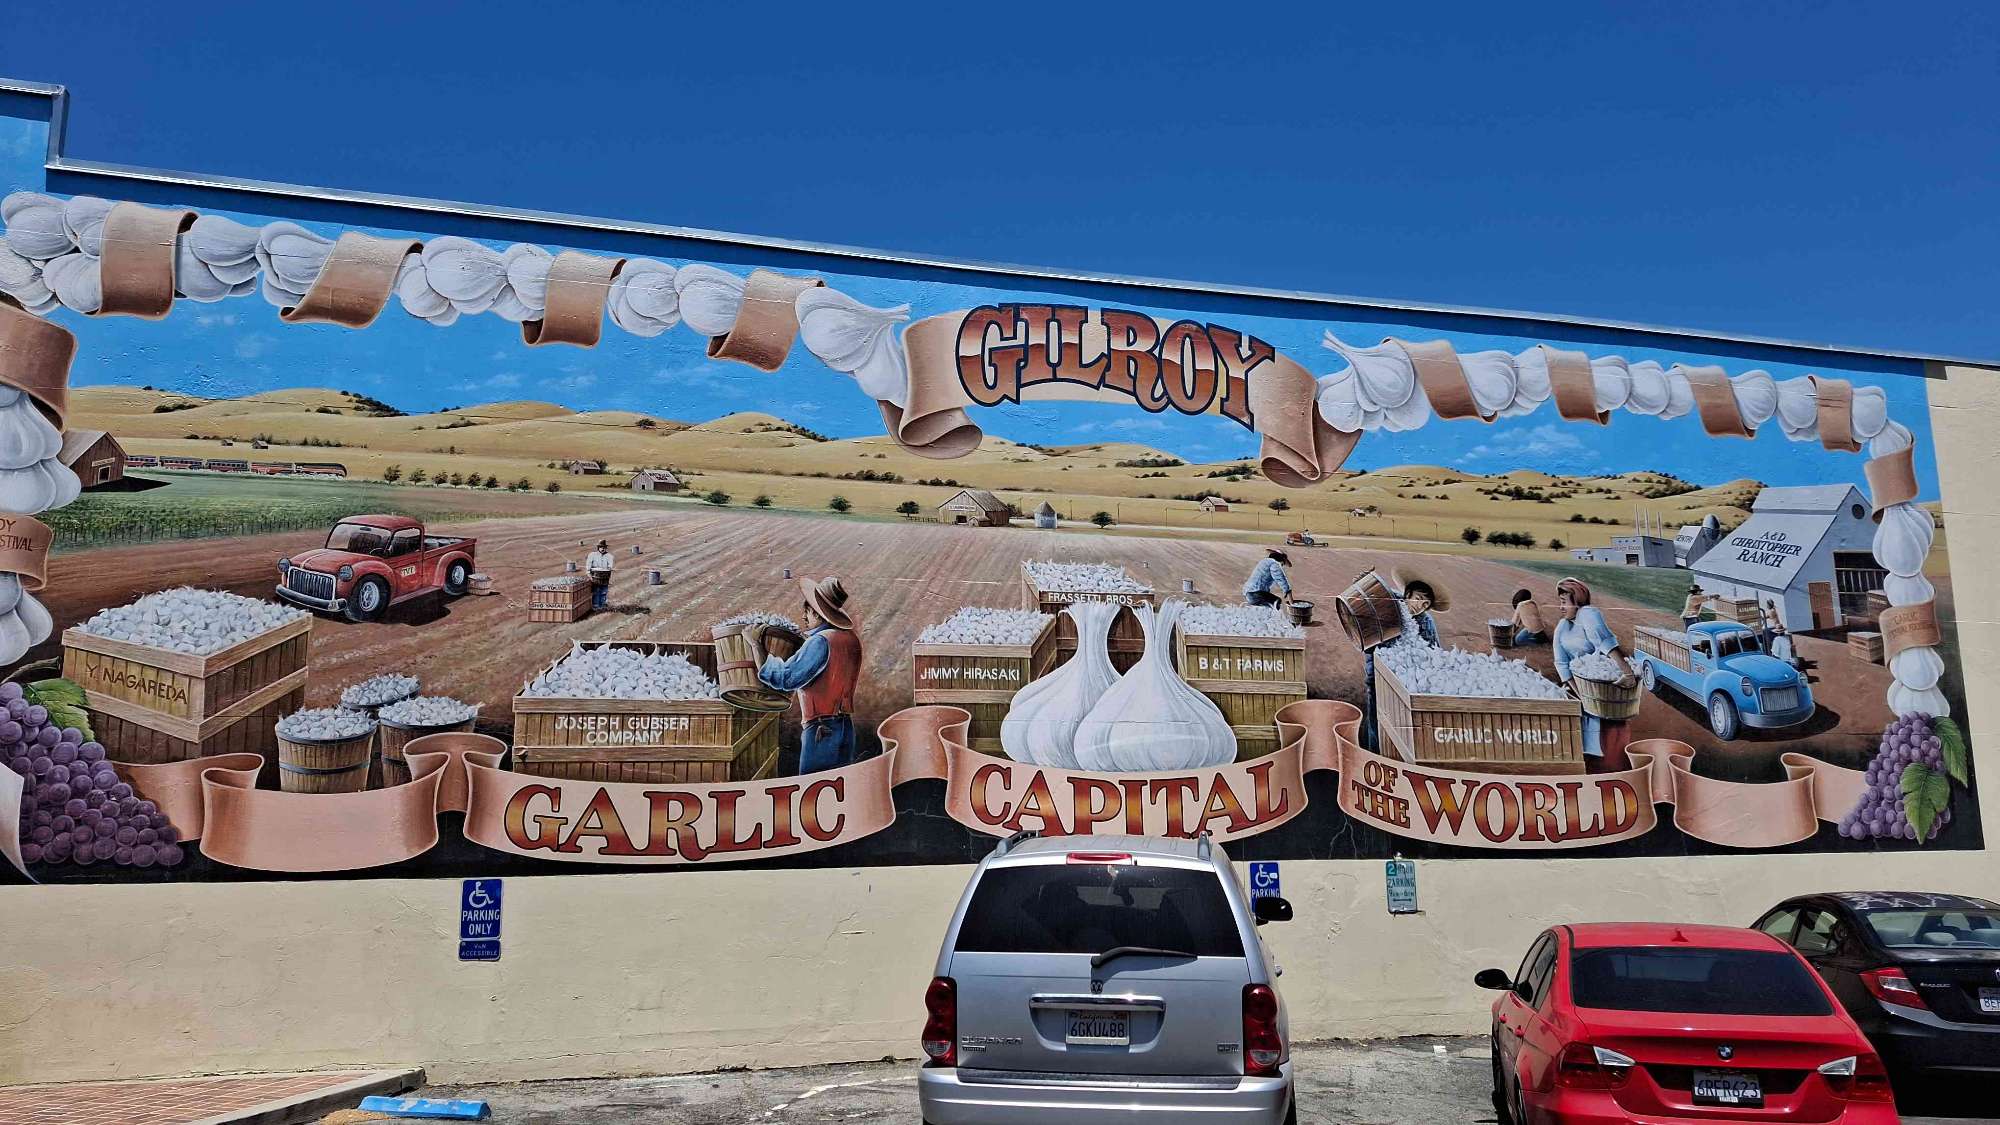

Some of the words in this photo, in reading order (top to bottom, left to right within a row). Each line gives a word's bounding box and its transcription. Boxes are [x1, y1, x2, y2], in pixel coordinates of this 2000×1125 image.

[955, 302, 1275, 432] GILROY
[1731, 537, 1802, 556] CHRISTOPHER
[1736, 548, 1787, 568] RANCH
[1048, 592, 1101, 603] FRASSETTI
[920, 667, 960, 680] JIMMY
[963, 667, 1020, 681] HIRASAKI
[1236, 659, 1284, 673] FARMS
[102, 667, 188, 705] NAGAREDA
[554, 716, 620, 730] JOSEPH
[627, 716, 689, 730] GUBSER
[586, 730, 663, 744] COMPANY
[1434, 727, 1493, 744] GARLIC
[1496, 728, 1558, 745] WORLD
[1363, 760, 1398, 793] OF
[503, 776, 846, 863] GARLIC
[969, 761, 1289, 839] CAPITAL
[1352, 779, 1411, 829] THE
[1402, 770, 1639, 843] WORLD
[1251, 888, 1280, 898] PARKING
[462, 909, 500, 921] PARKING
[468, 923, 492, 936] ONLY
[1070, 1021, 1125, 1037] 6GKU488
